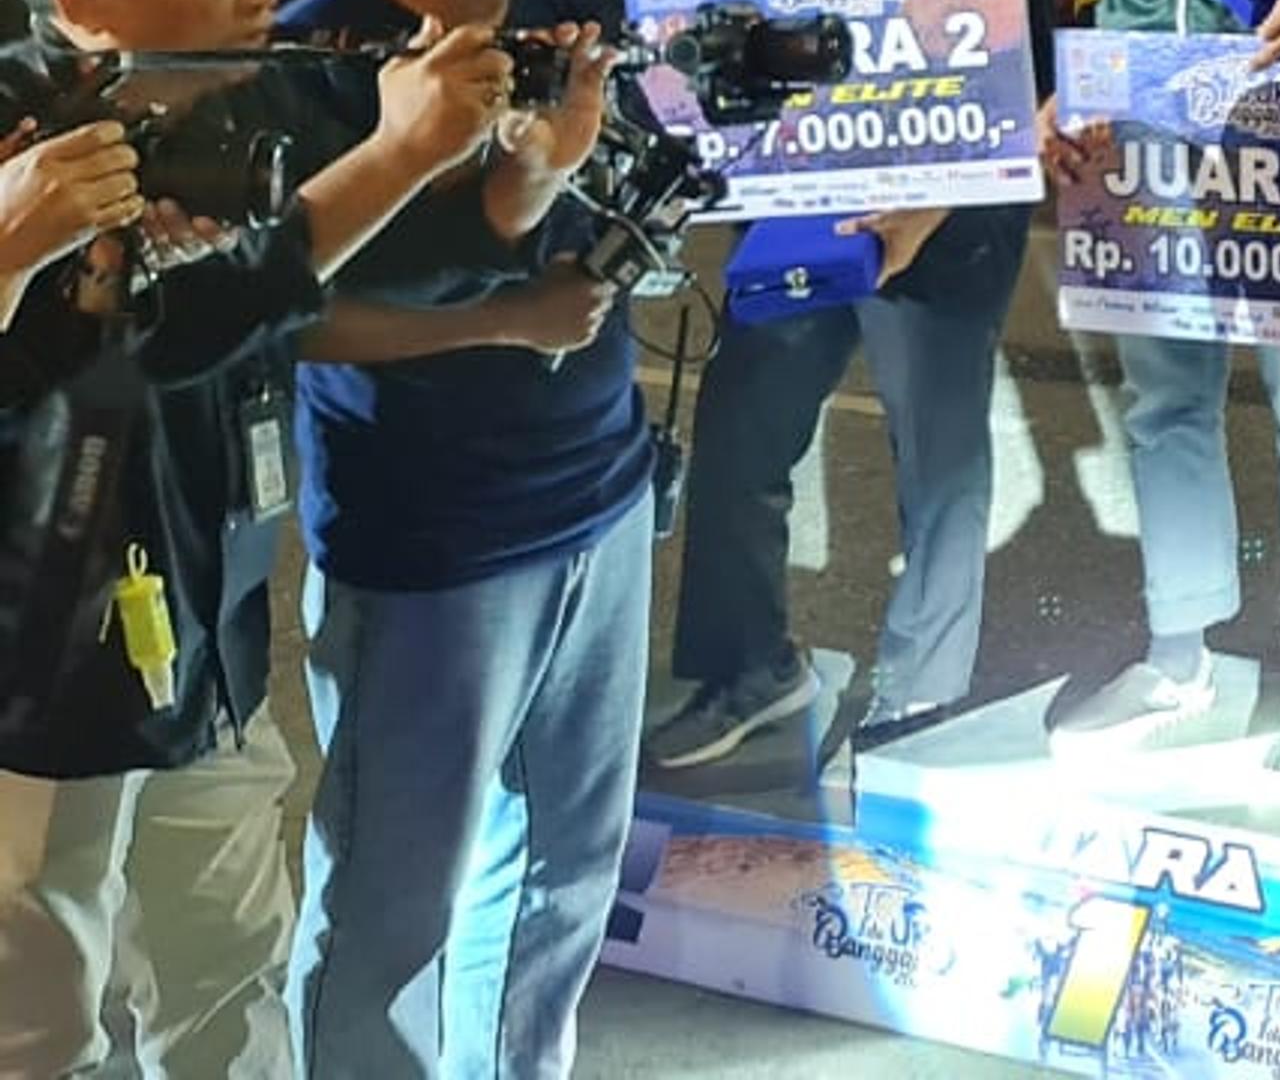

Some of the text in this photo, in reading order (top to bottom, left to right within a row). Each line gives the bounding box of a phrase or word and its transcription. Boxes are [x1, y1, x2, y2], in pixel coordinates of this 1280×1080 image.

[946, 12, 989, 68] 2
[830, 74, 967, 105] ELITE
[1122, 205, 1218, 229] MEN
[1064, 230, 1133, 278] Rp.
